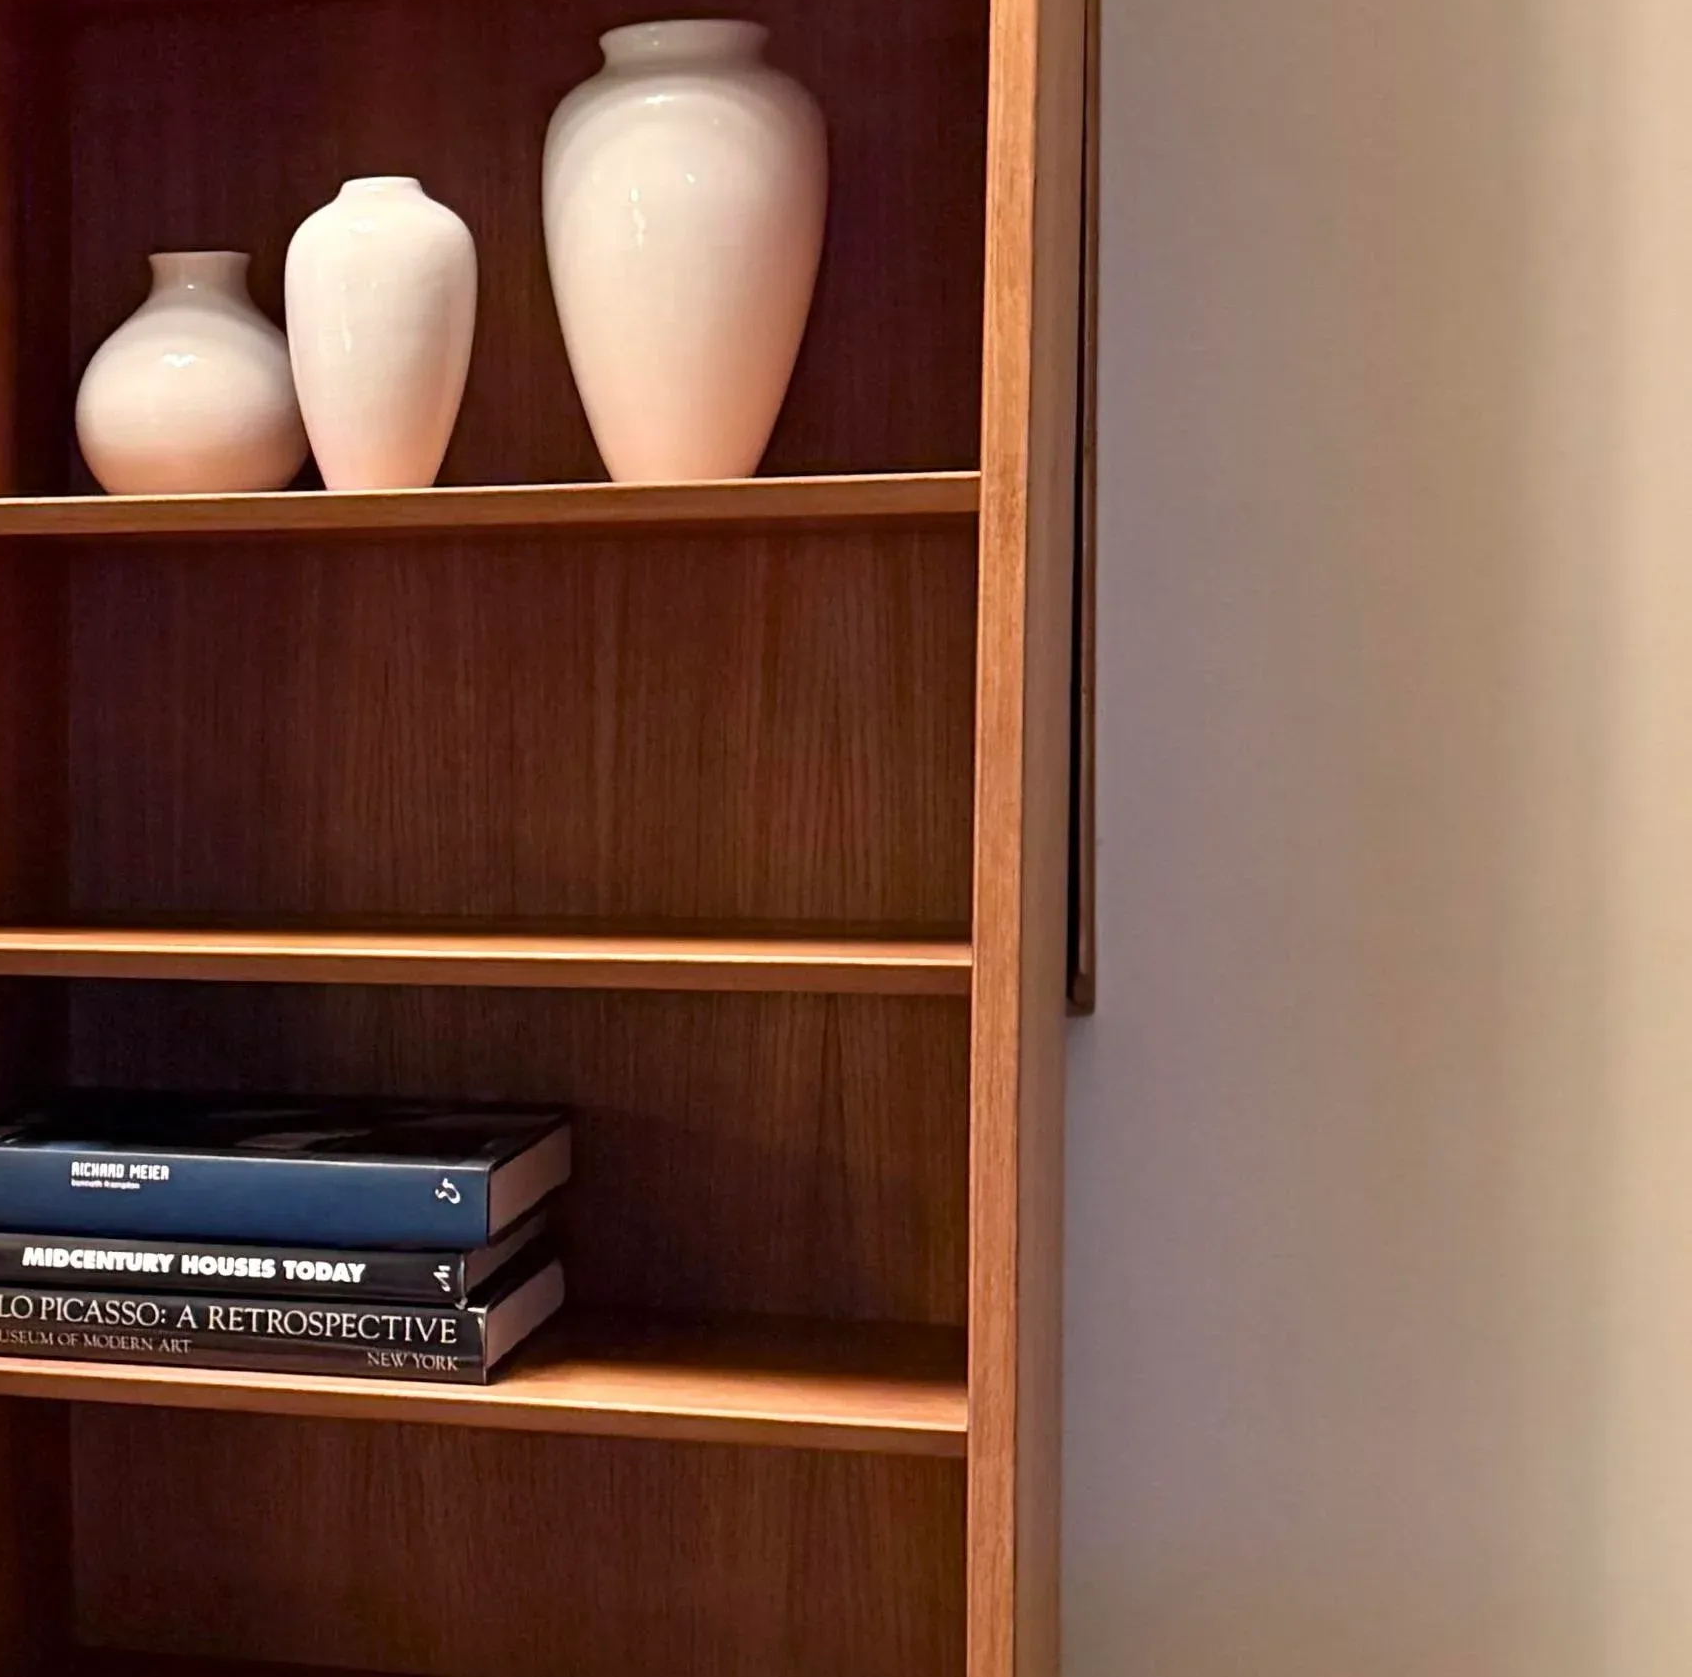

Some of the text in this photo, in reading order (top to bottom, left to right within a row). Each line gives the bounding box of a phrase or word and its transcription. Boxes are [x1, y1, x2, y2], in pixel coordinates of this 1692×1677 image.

[71, 1161, 170, 1180] RICHARD MEIER
[22, 1246, 367, 1283] MIDCENTURY HOUSES TODAY
[39, 1296, 167, 1327] PICASSO:
[176, 1304, 199, 1330] A
[208, 1305, 457, 1344] RETROSPECTIVE
[57, 1332, 79, 1347] OF
[83, 1333, 154, 1352] MODERN
[158, 1338, 193, 1354] ART
[368, 1351, 406, 1369] NEW
[411, 1353, 459, 1372] YORK
